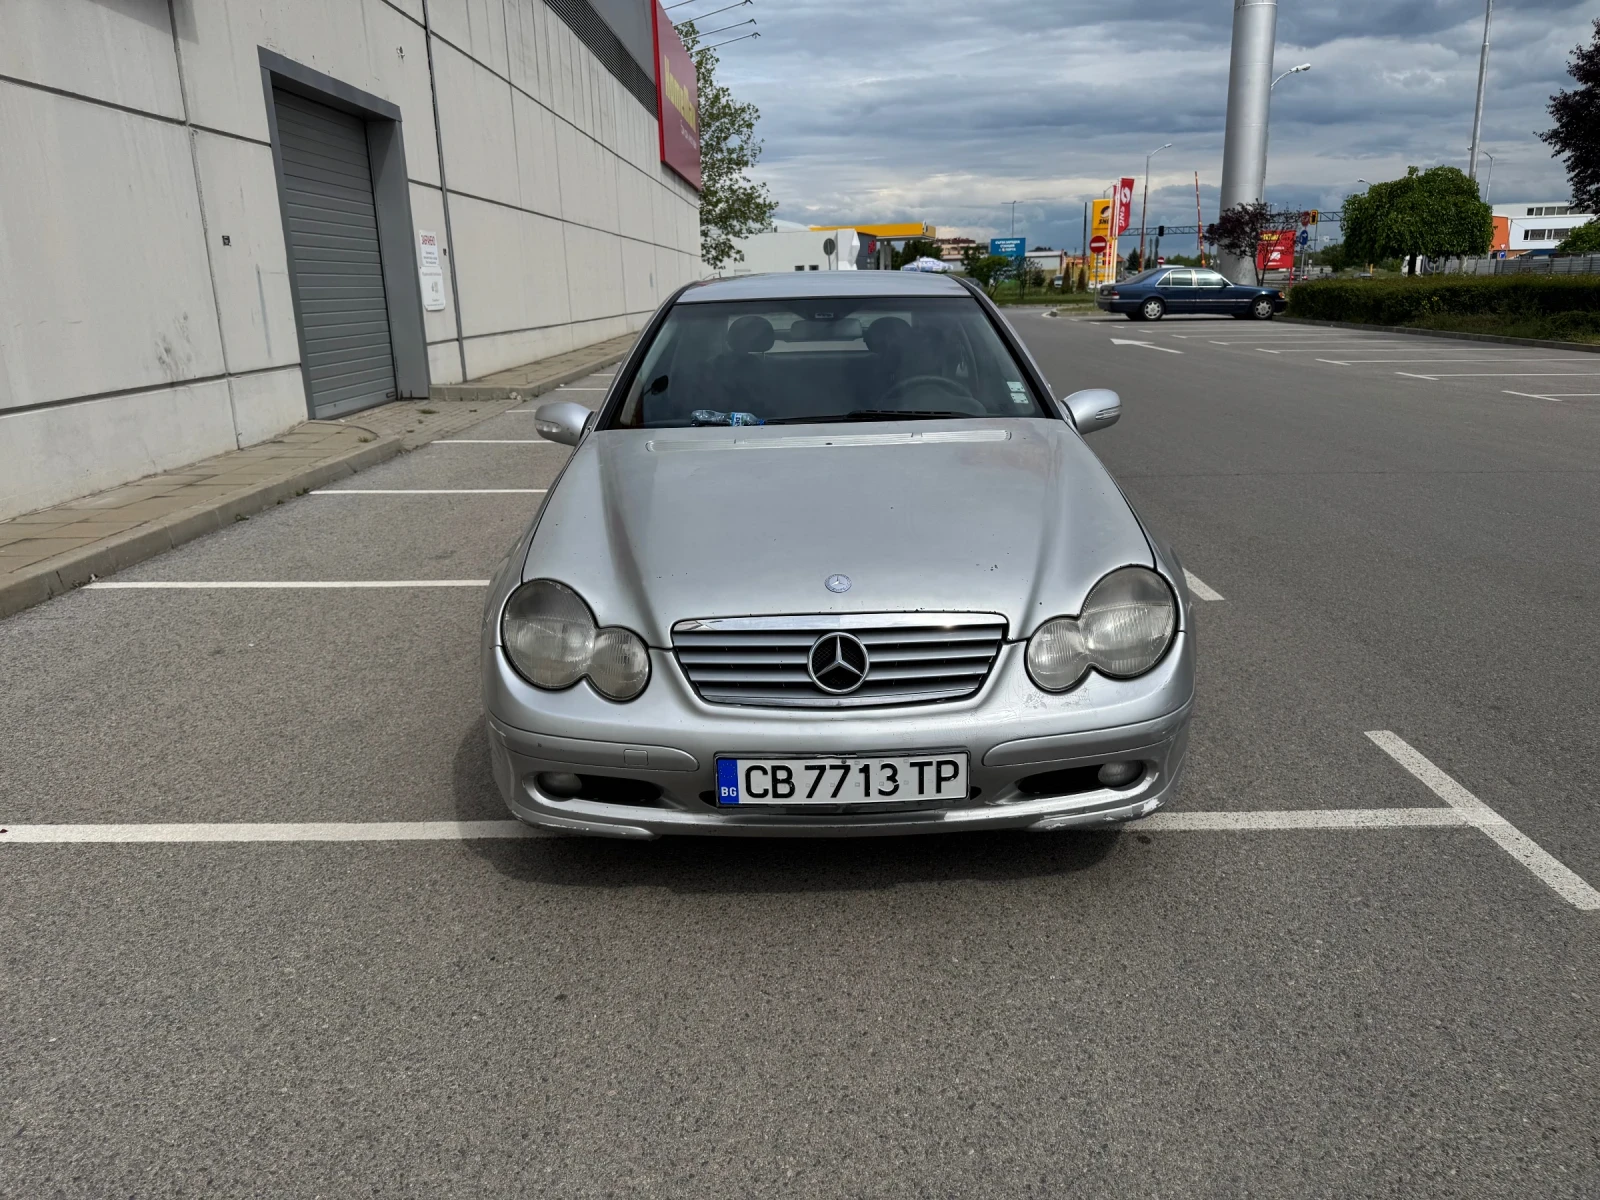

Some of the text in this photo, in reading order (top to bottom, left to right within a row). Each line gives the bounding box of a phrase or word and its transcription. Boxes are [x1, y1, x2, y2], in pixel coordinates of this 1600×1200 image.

[721, 786, 737, 797] BG
[745, 759, 960, 799] CB 7713 TP
